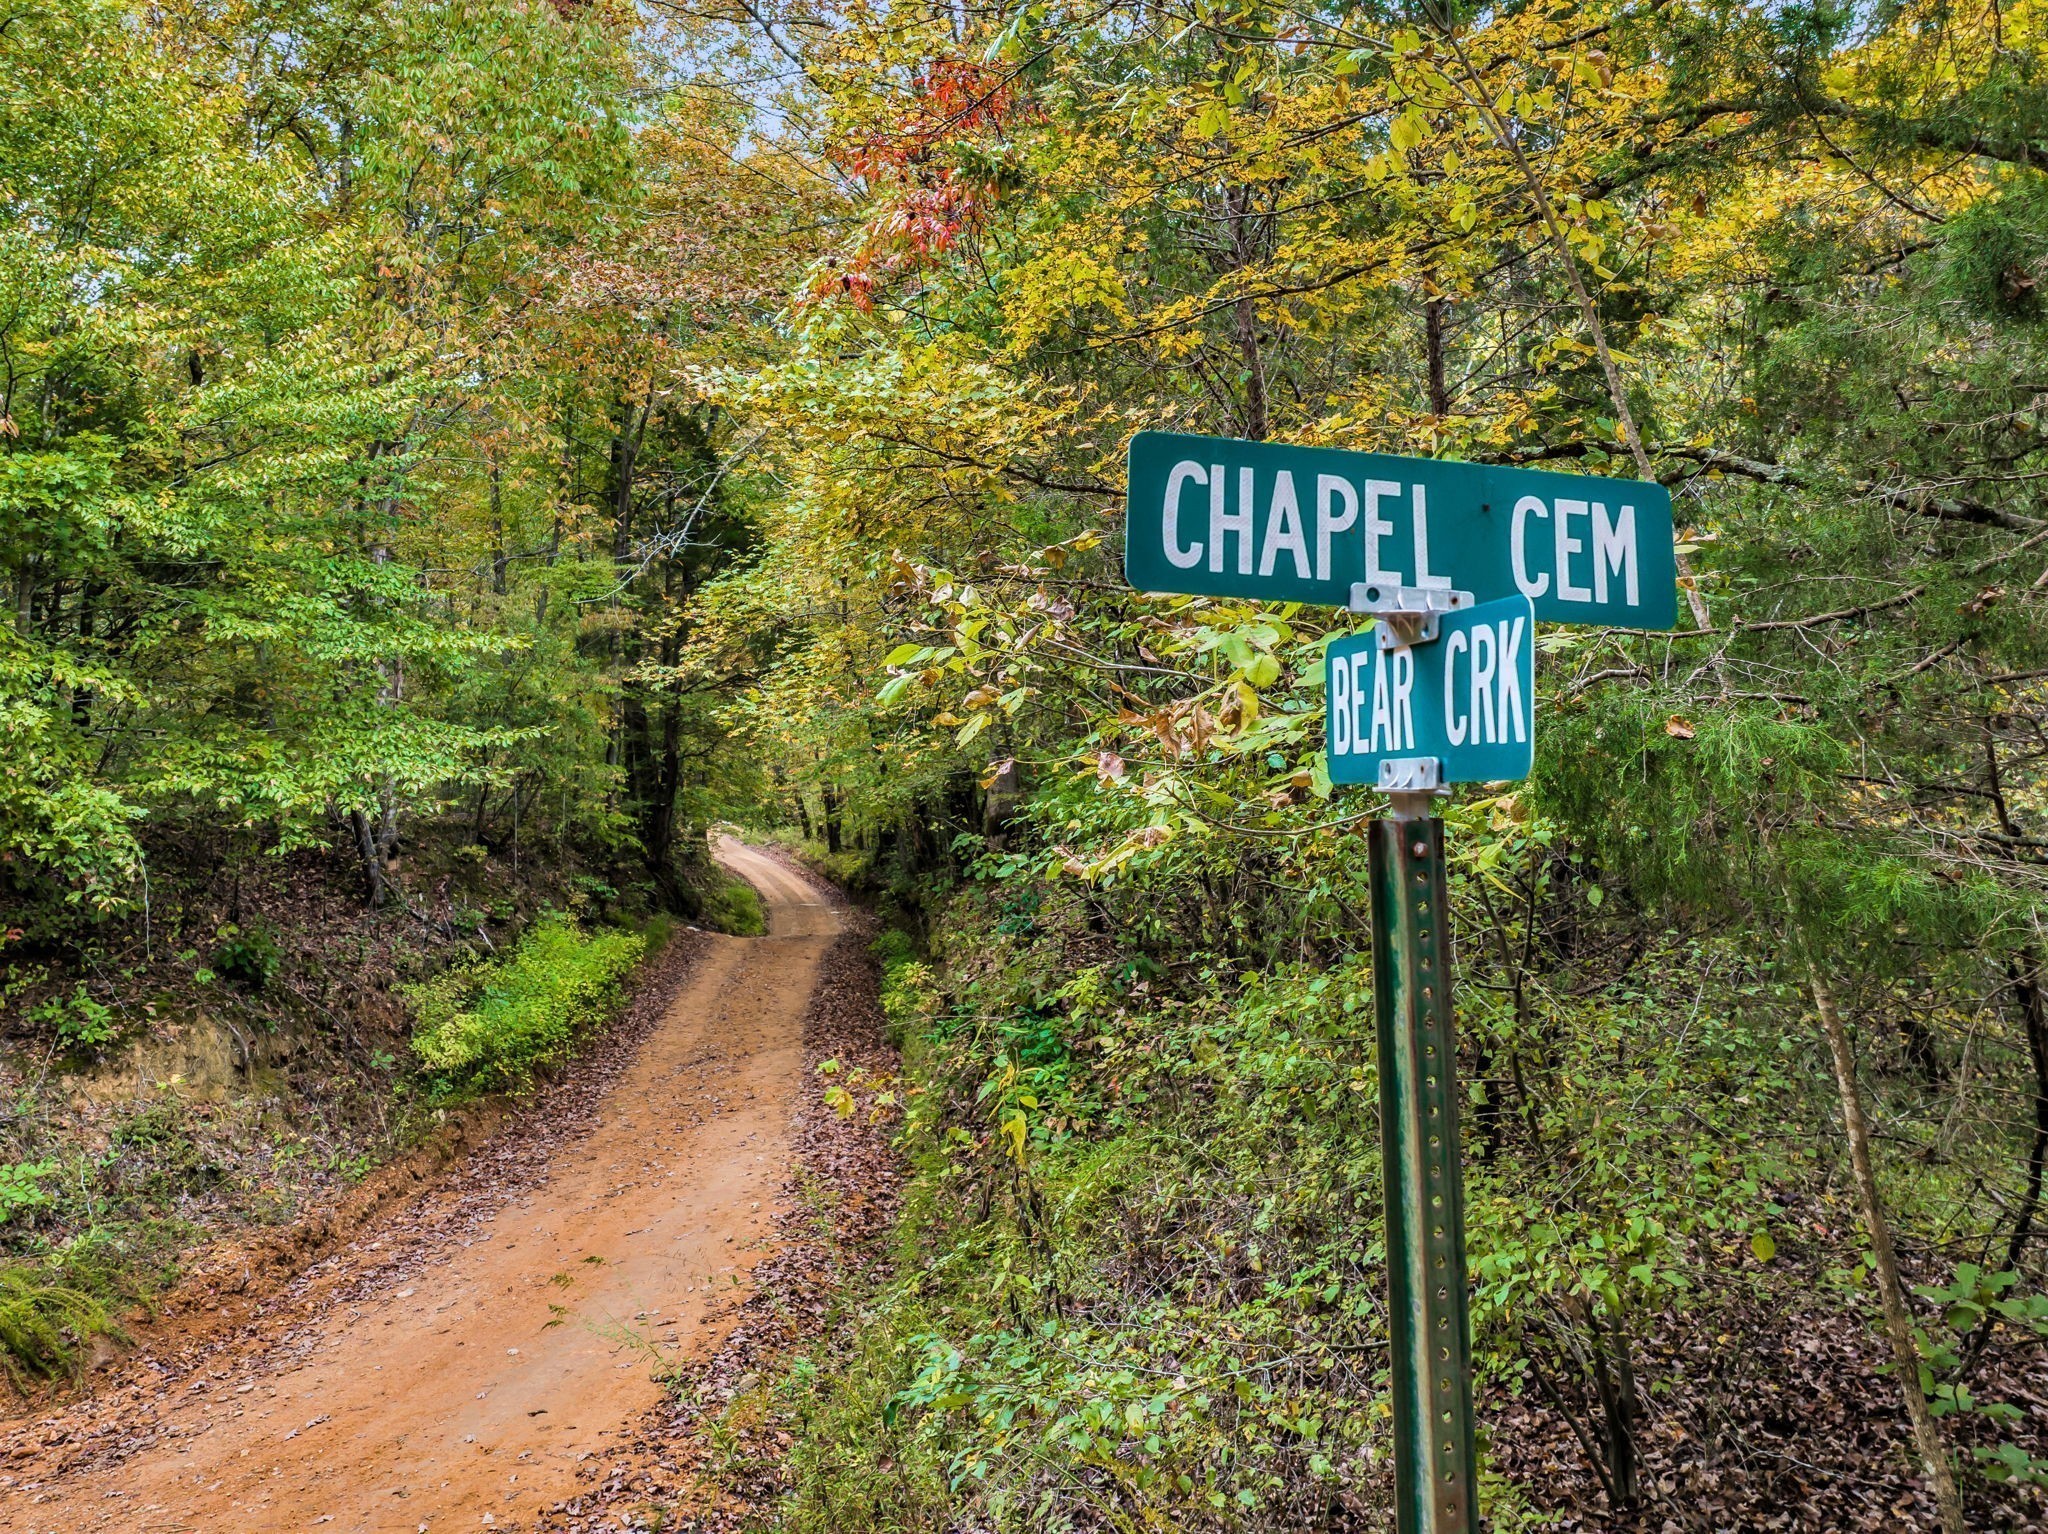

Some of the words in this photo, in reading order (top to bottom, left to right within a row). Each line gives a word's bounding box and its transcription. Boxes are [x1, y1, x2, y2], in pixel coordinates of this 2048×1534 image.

[1162, 460, 1452, 589] CHAPEL
[1510, 495, 1639, 606] CEM
[1332, 646, 1415, 755] BEAR
[1444, 616, 1527, 747] CRK
